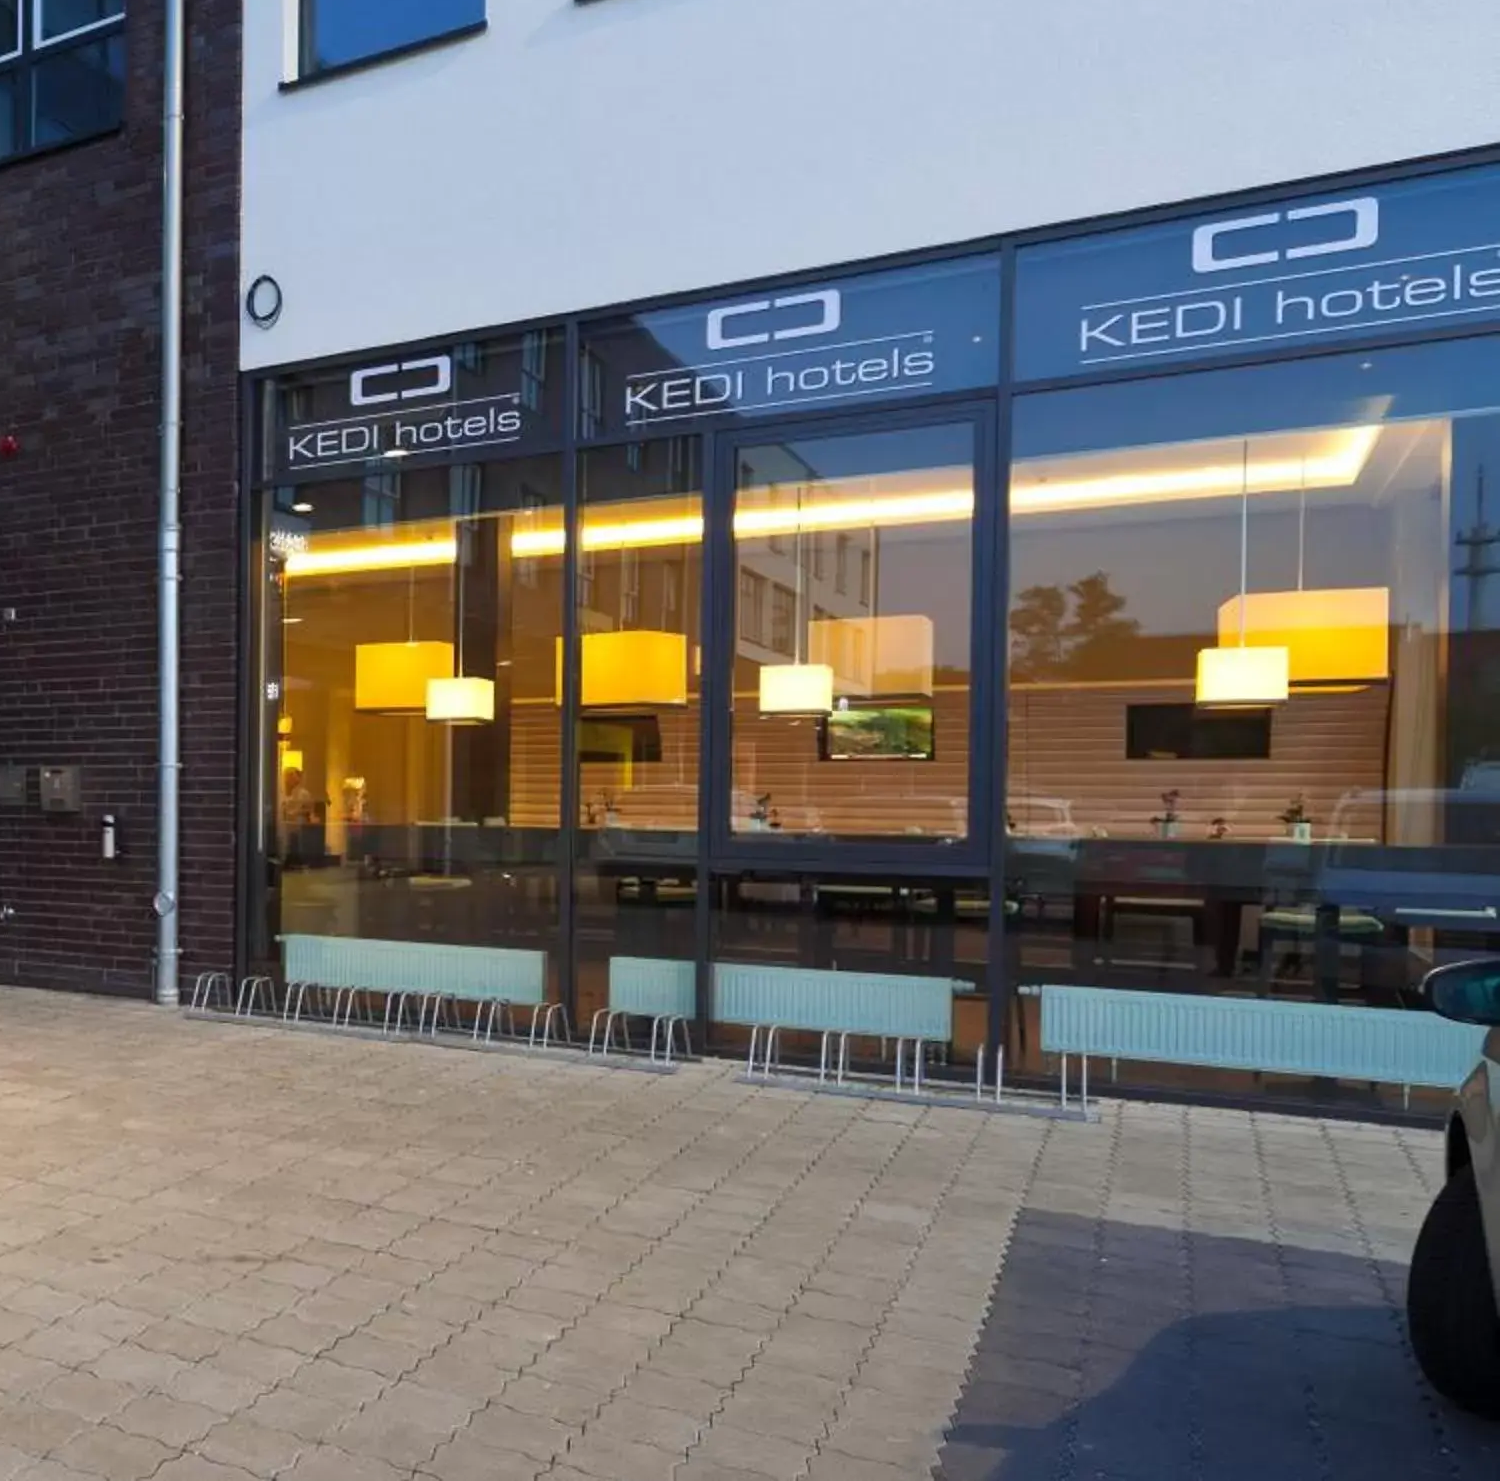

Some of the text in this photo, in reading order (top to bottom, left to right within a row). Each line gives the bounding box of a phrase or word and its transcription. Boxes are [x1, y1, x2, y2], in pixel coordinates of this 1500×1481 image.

[1080, 264, 1500, 352] KEDI hotels
[625, 348, 935, 414] KEDI hotels
[288, 407, 521, 460] KEDI hotels
